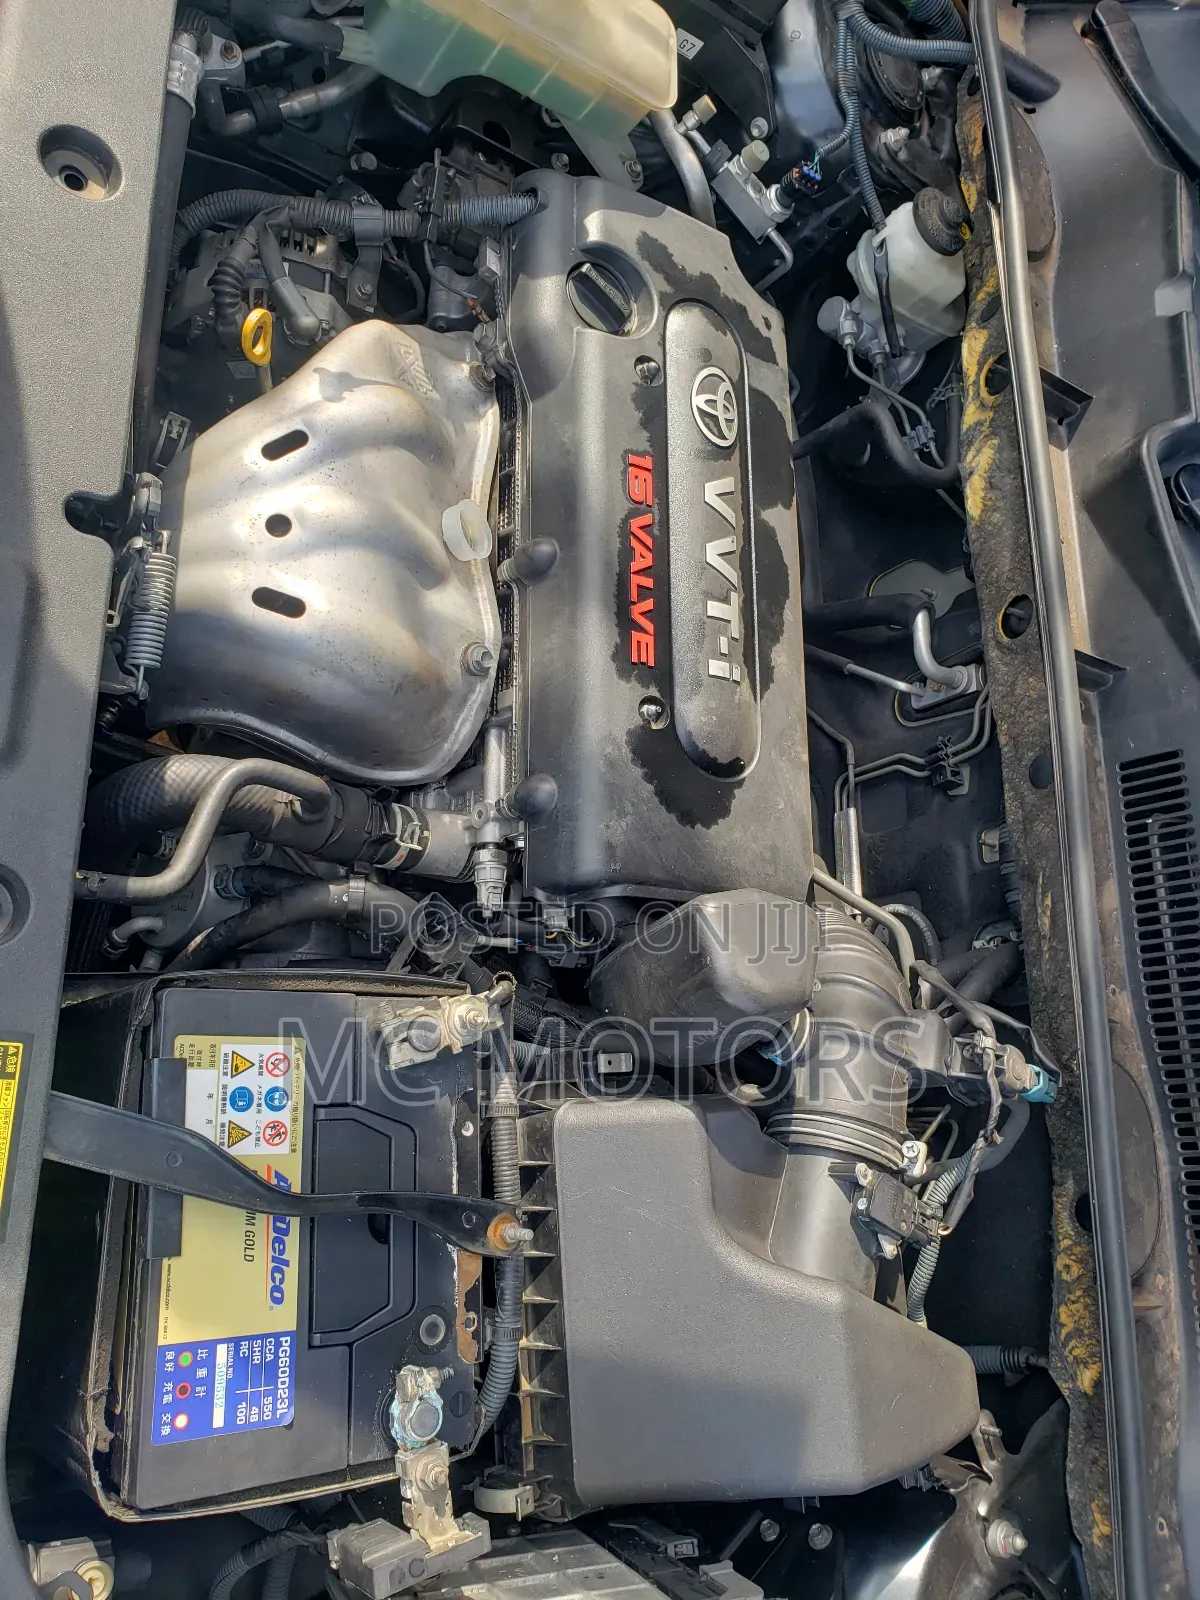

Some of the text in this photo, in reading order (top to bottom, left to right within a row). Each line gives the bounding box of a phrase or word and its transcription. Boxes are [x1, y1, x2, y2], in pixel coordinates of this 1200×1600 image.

[679, 38, 696, 53] G7
[627, 453, 656, 668] 16 VALVE
[703, 476, 742, 685] VVT-i
[243, 1230, 255, 1262] GOLD
[270, 1170, 292, 1305] ADelco
[162, 1381, 173, 1404] 充電
[164, 1351, 175, 1372] 良好
[214, 1363, 226, 1408] 509532
[237, 1342, 248, 1424] RC 100
[250, 1340, 261, 1422] 5HR 48
[264, 1338, 274, 1420] CCA 550
[276, 1336, 290, 1418] PG60D23L
[160, 1413, 171, 1436] 交換
